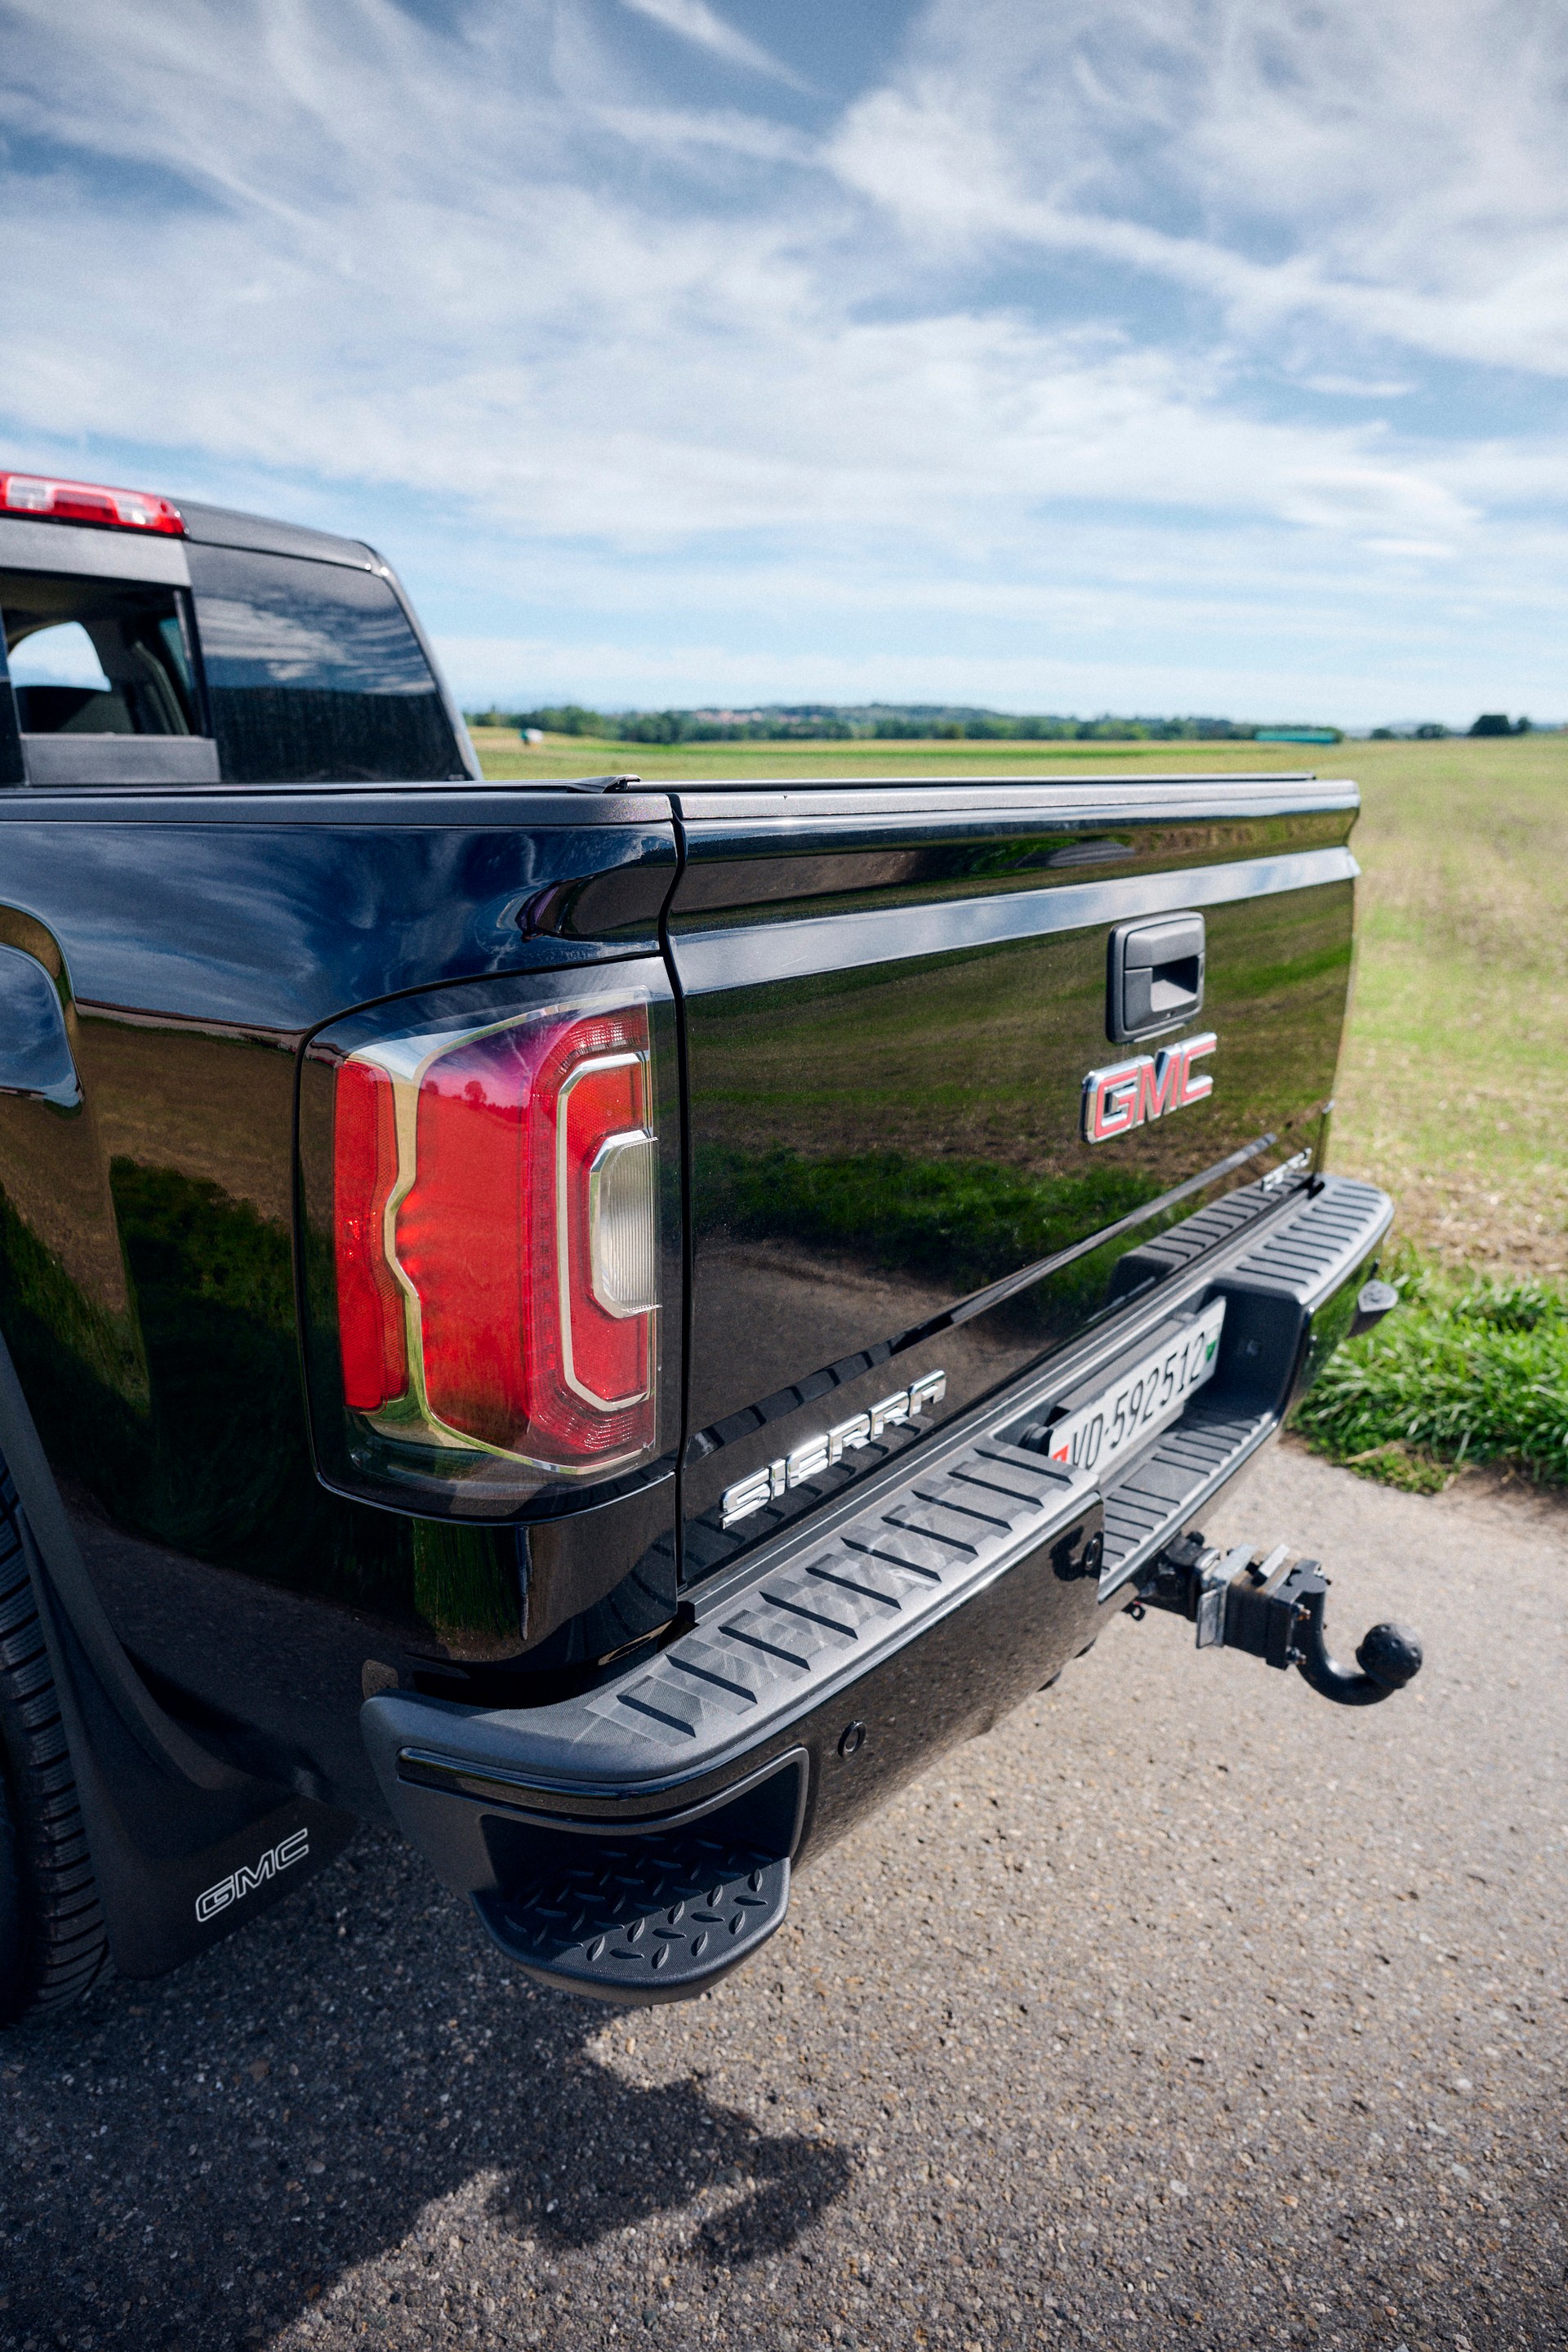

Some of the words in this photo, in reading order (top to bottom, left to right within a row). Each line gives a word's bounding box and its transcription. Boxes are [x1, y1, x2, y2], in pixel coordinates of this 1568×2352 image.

[1080, 1031, 1218, 1144] GMC
[719, 1370, 947, 1530] SIERRA
[195, 1827, 310, 1922] GMC
